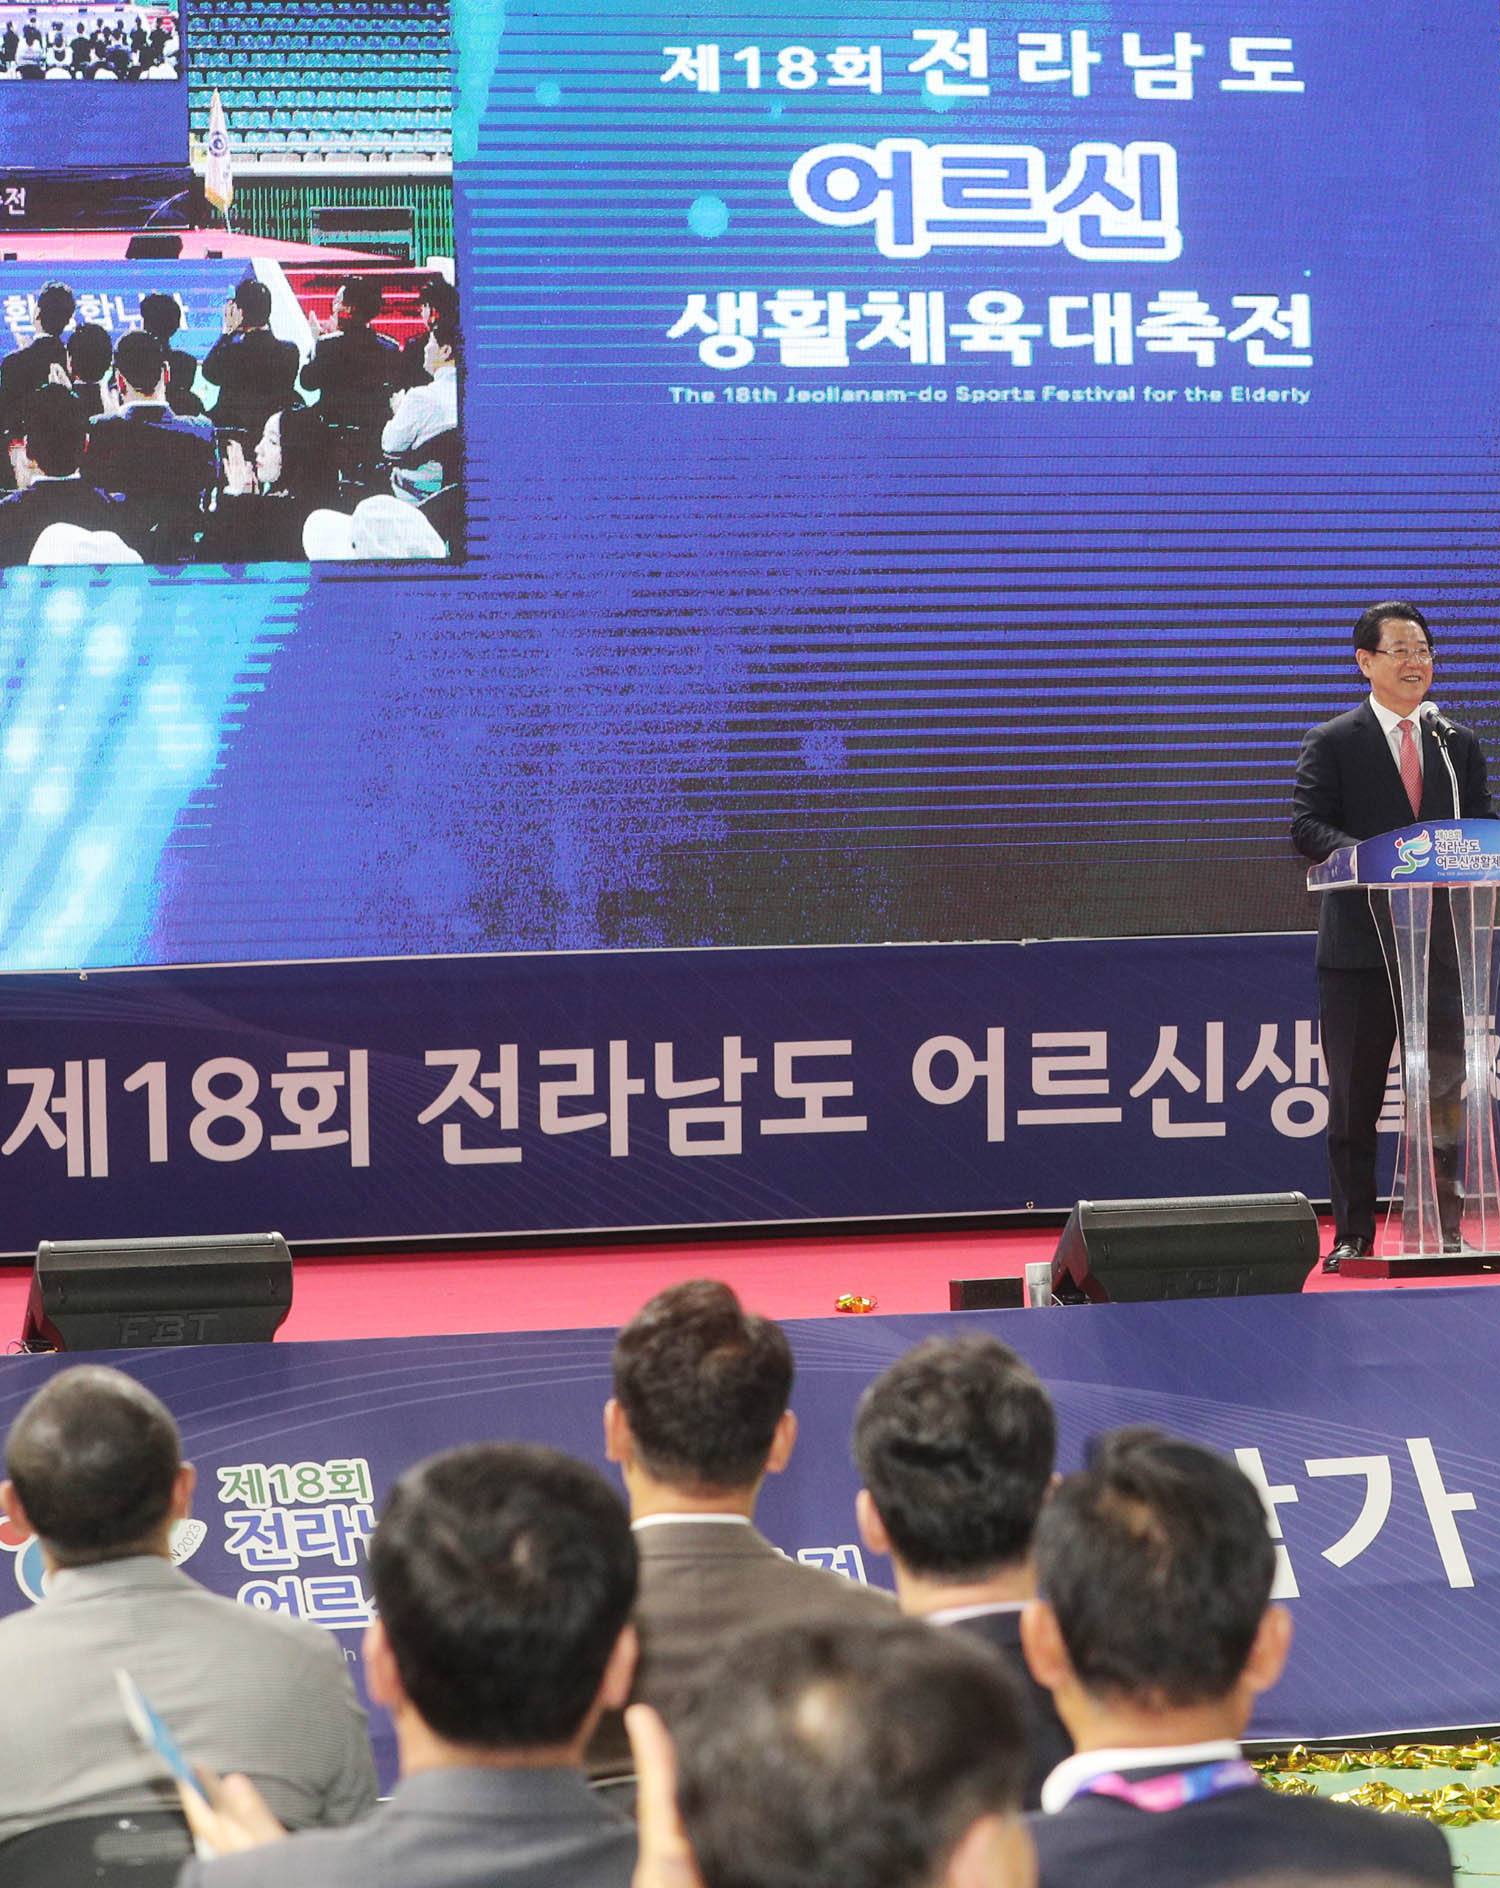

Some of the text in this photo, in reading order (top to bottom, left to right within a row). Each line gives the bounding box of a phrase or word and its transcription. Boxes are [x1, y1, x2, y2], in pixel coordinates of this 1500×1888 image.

[661, 28, 1305, 100] 제18회 전라남도
[789, 138, 1182, 261] 어르신
[667, 289, 1313, 370] 생활체육대축전
[668, 385, 1312, 405] The 18th Jeollanam-do Sports Festival for the Elderly
[1435, 840, 1480, 854] 전라남도
[1, 1049, 370, 1177] 제18회
[417, 1035, 868, 1165] 전라남도
[217, 1458, 374, 1508] 제18회
